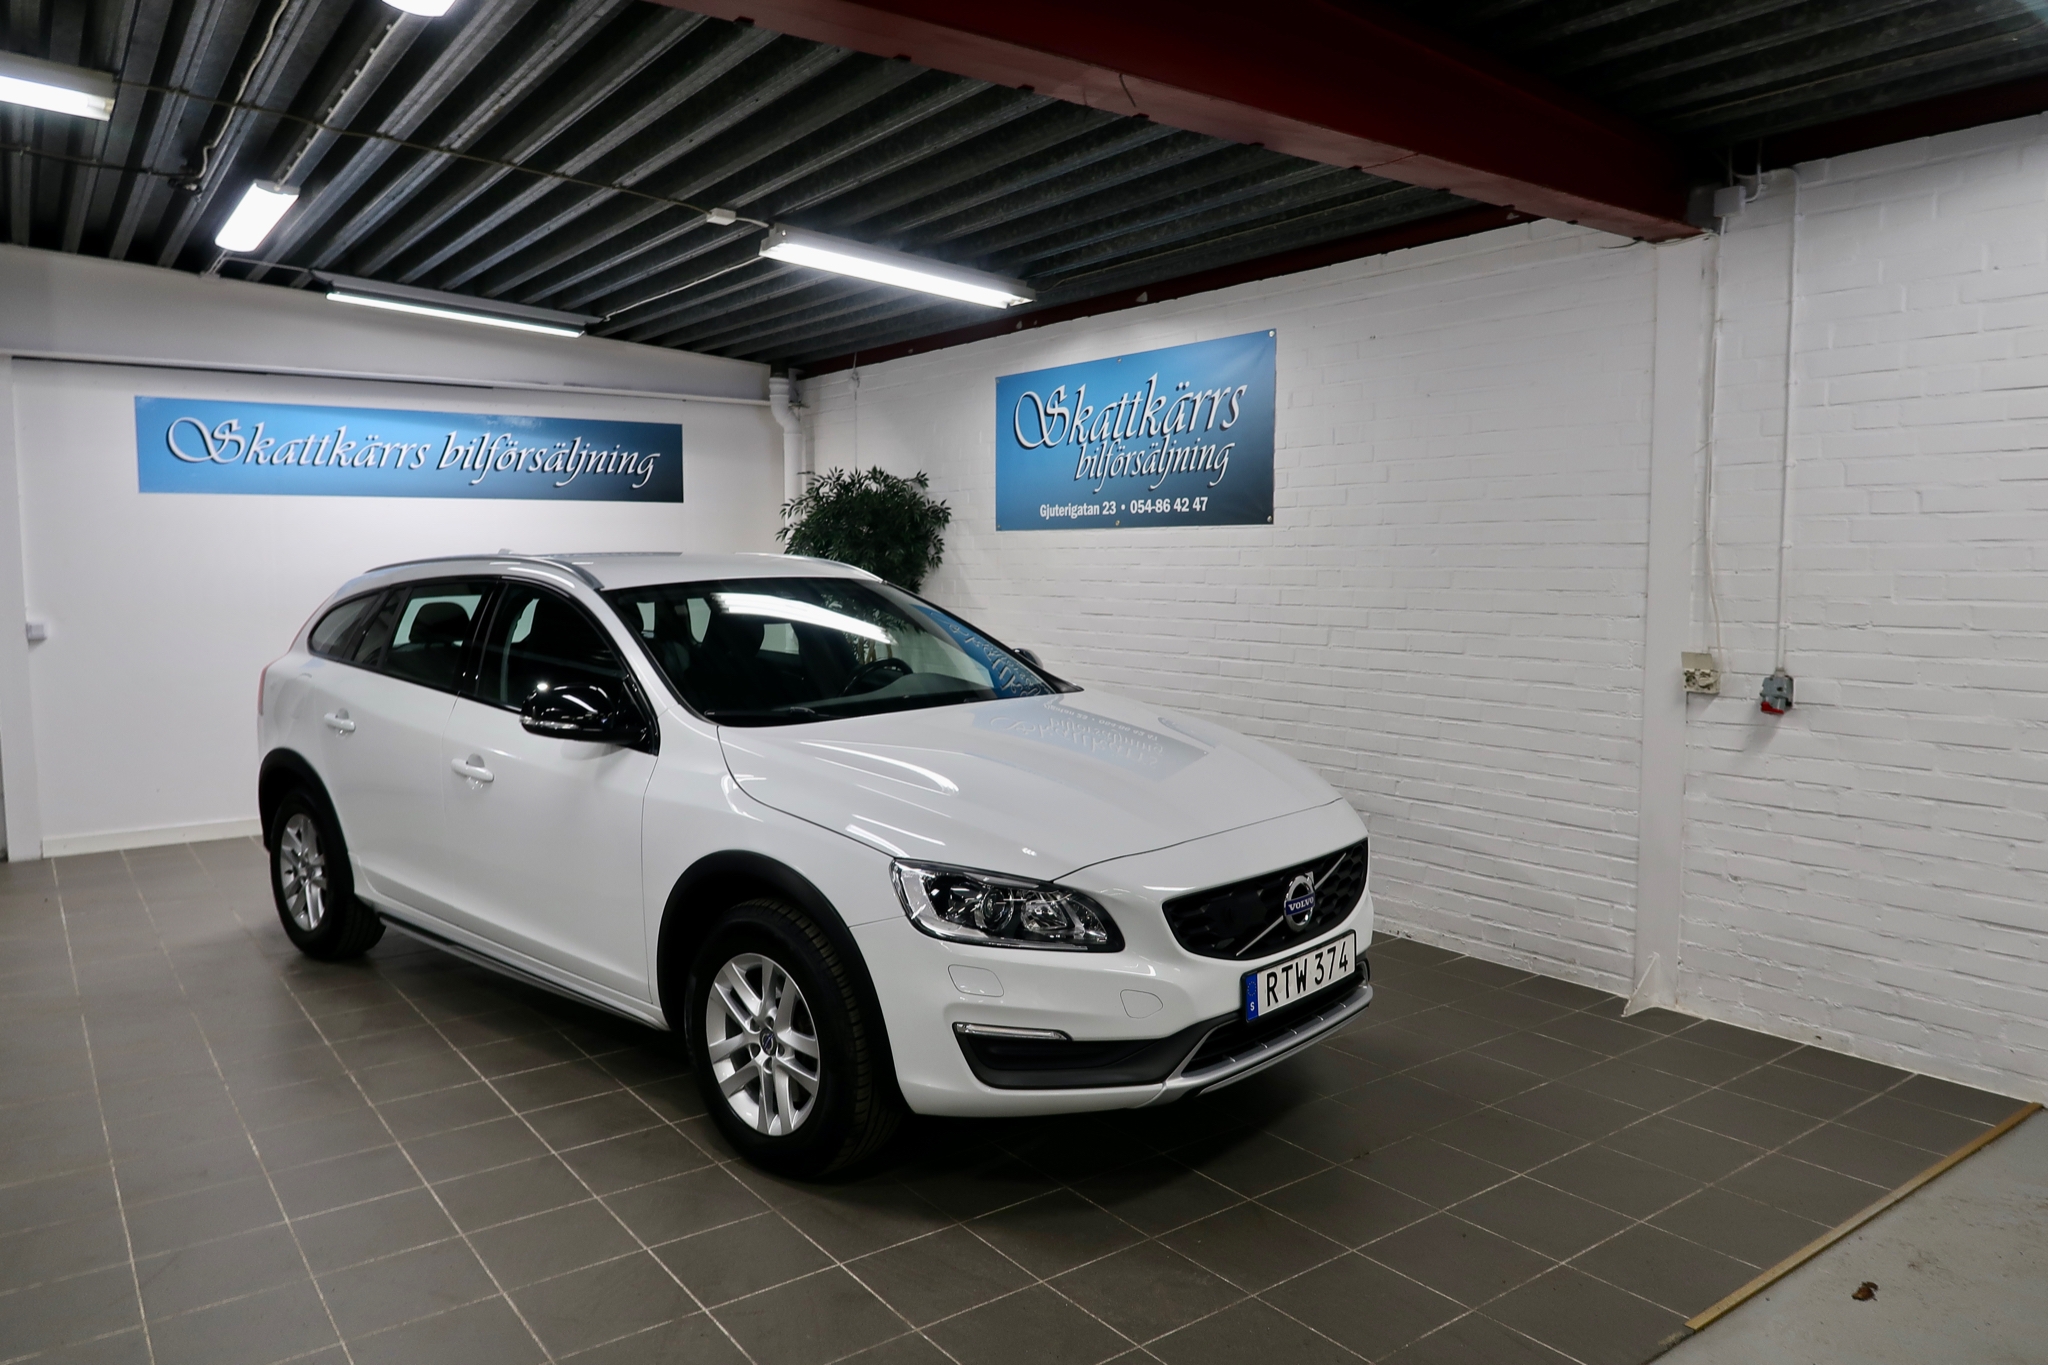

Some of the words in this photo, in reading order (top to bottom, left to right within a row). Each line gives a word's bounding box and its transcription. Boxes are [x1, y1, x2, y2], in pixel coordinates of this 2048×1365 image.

[1015, 372, 1248, 449] Skattkärrs
[166, 417, 431, 468] Skattkärrs
[437, 431, 661, 490] bilförsäljning
[1074, 436, 1236, 494] bilförsäljning
[1040, 503, 1100, 520] Gjuterigatan
[1102, 501, 1117, 515] 23
[1129, 498, 1171, 514] 054-86
[1173, 497, 1190, 513] 42
[1192, 496, 1209, 512] 47
[1288, 896, 1315, 912] VOLVO
[1266, 958, 1308, 1007] RTW
[1314, 941, 1348, 985] 374
[1249, 1001, 1256, 1012] S
